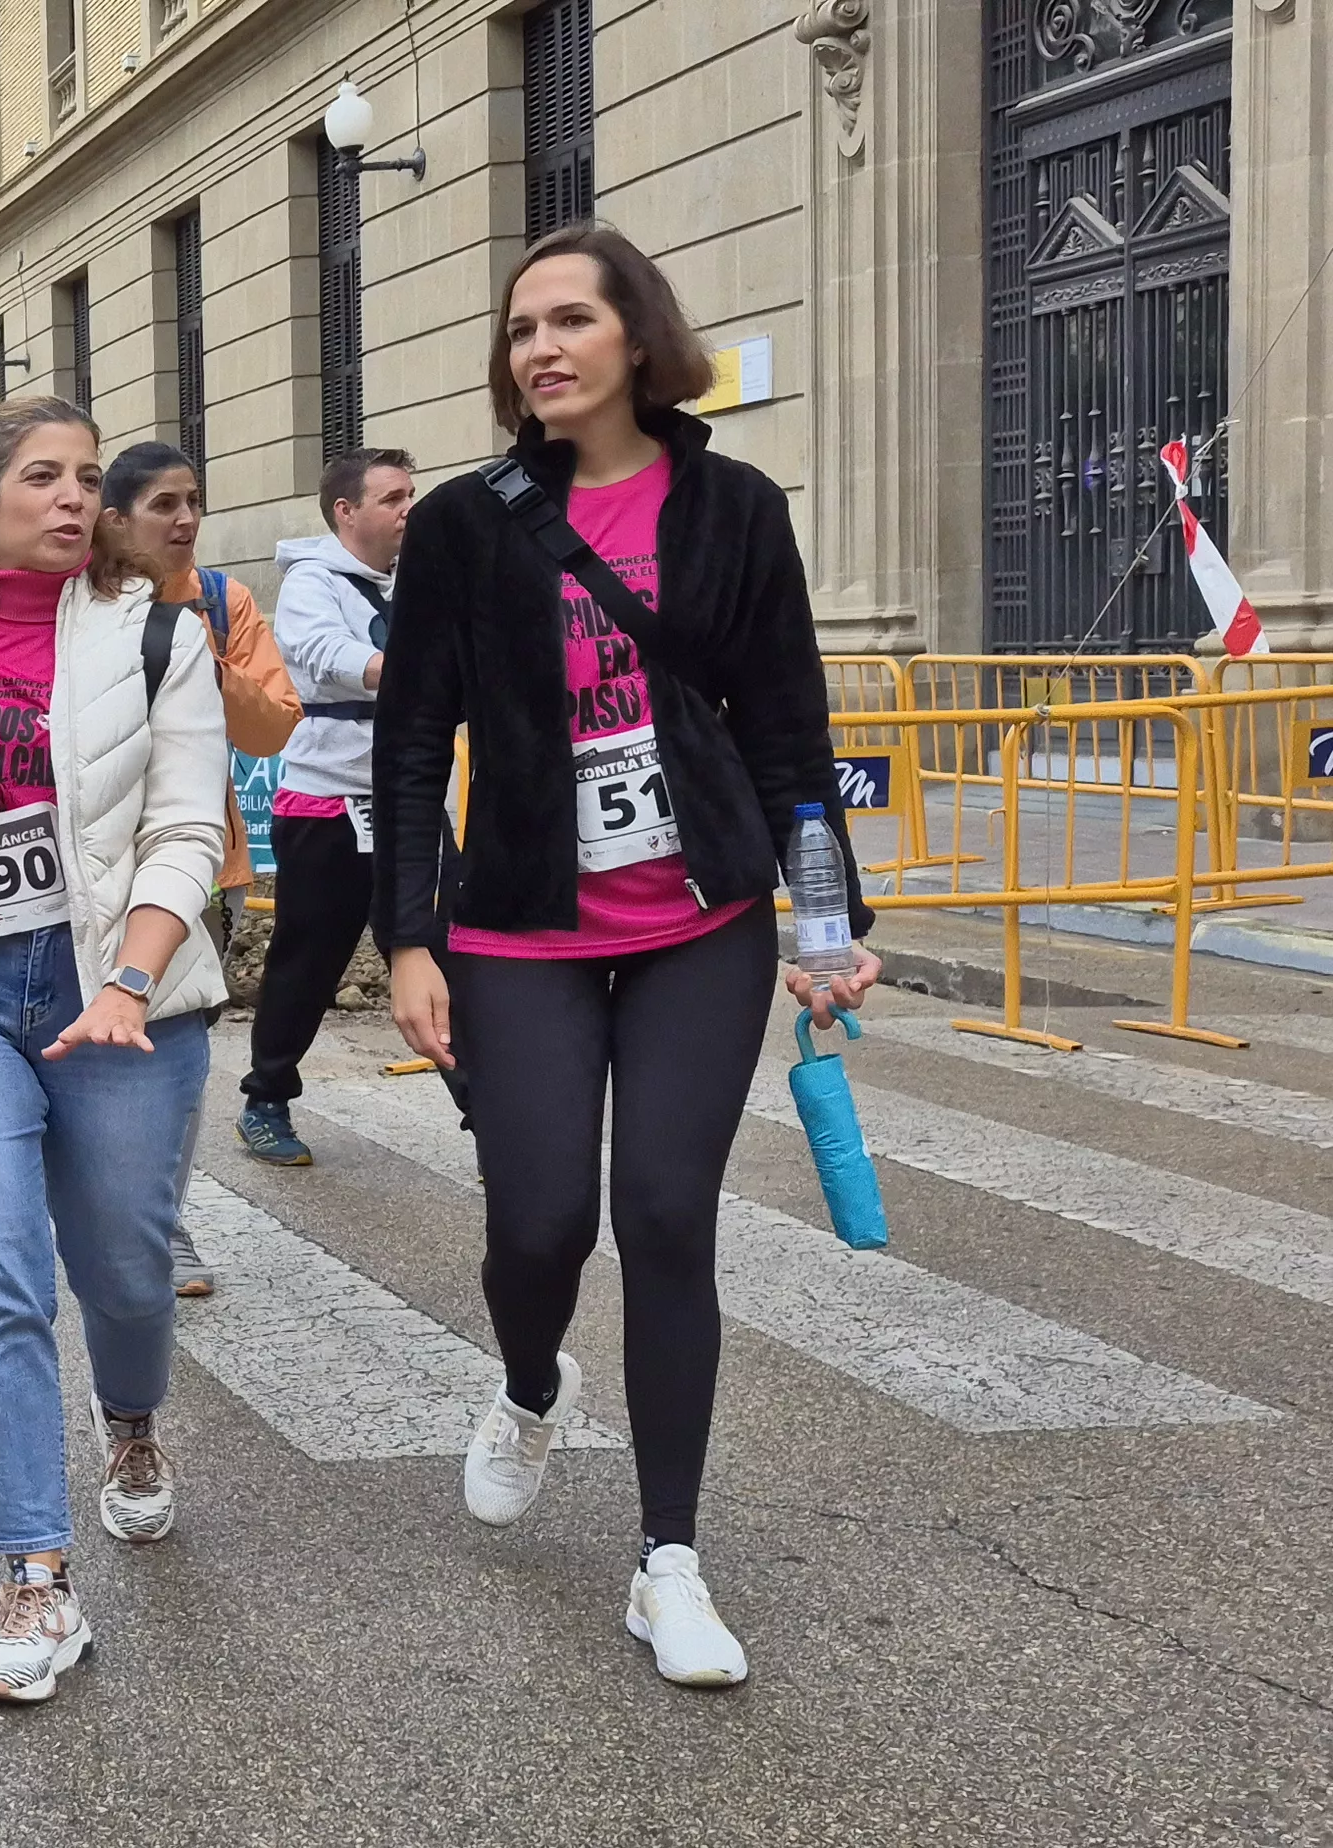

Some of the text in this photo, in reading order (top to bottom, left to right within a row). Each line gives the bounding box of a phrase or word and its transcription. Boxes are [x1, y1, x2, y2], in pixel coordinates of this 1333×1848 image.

[641, 566, 655, 576] EL
[596, 636, 632, 680] EN
[30, 690, 44, 698] EL
[575, 753, 657, 781] CONTRA EL
[598, 772, 671, 830] 51
[243, 820, 272, 835] iari
